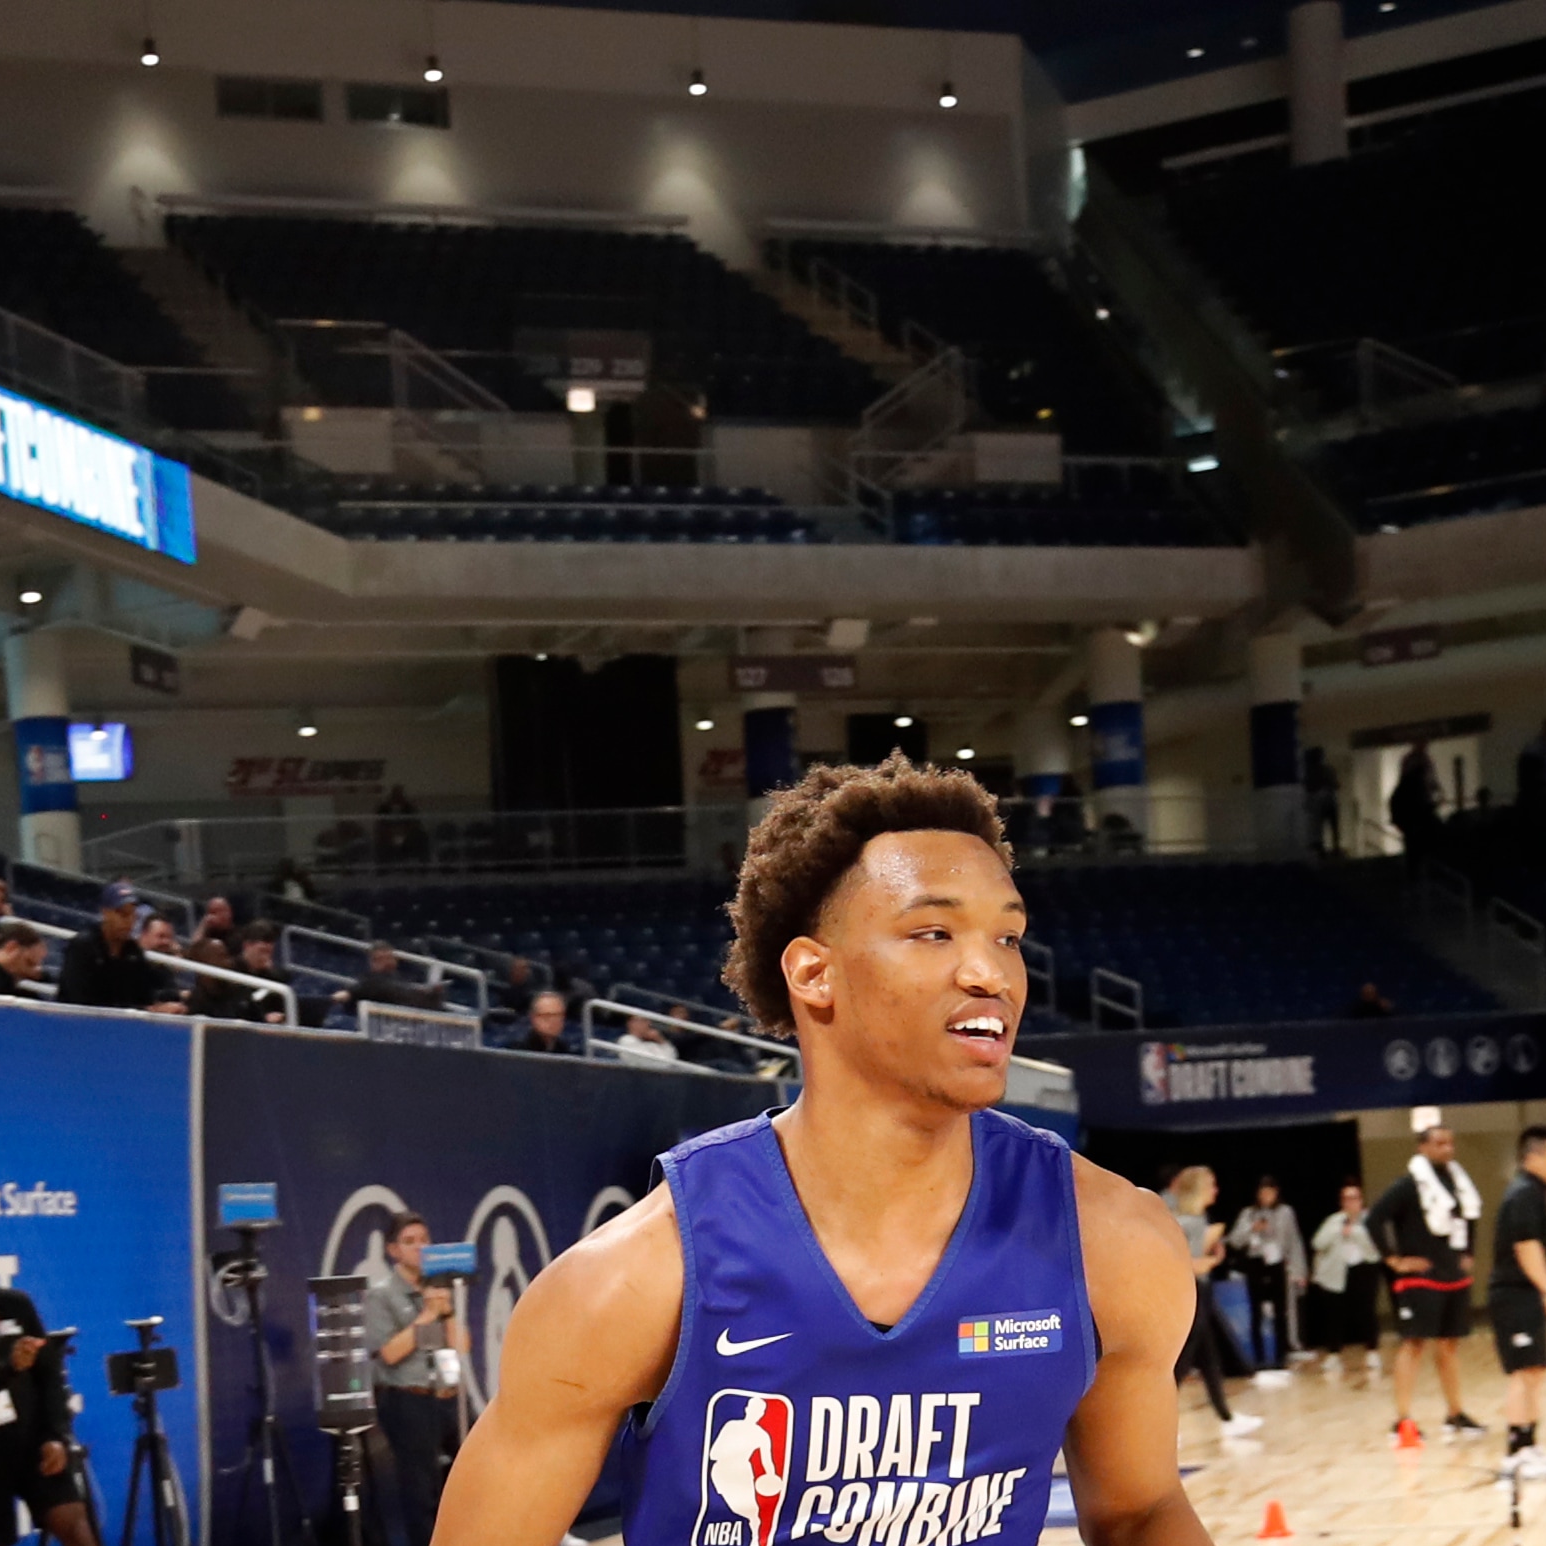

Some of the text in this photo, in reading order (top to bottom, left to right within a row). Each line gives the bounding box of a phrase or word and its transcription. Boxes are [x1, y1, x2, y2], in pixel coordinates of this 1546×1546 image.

[3, 1179, 77, 1217] Surface
[995, 1314, 1061, 1335] Microsoft
[995, 1334, 1049, 1351] Surface
[806, 1393, 981, 1482] DRAFT
[704, 1520, 743, 1546] NBA
